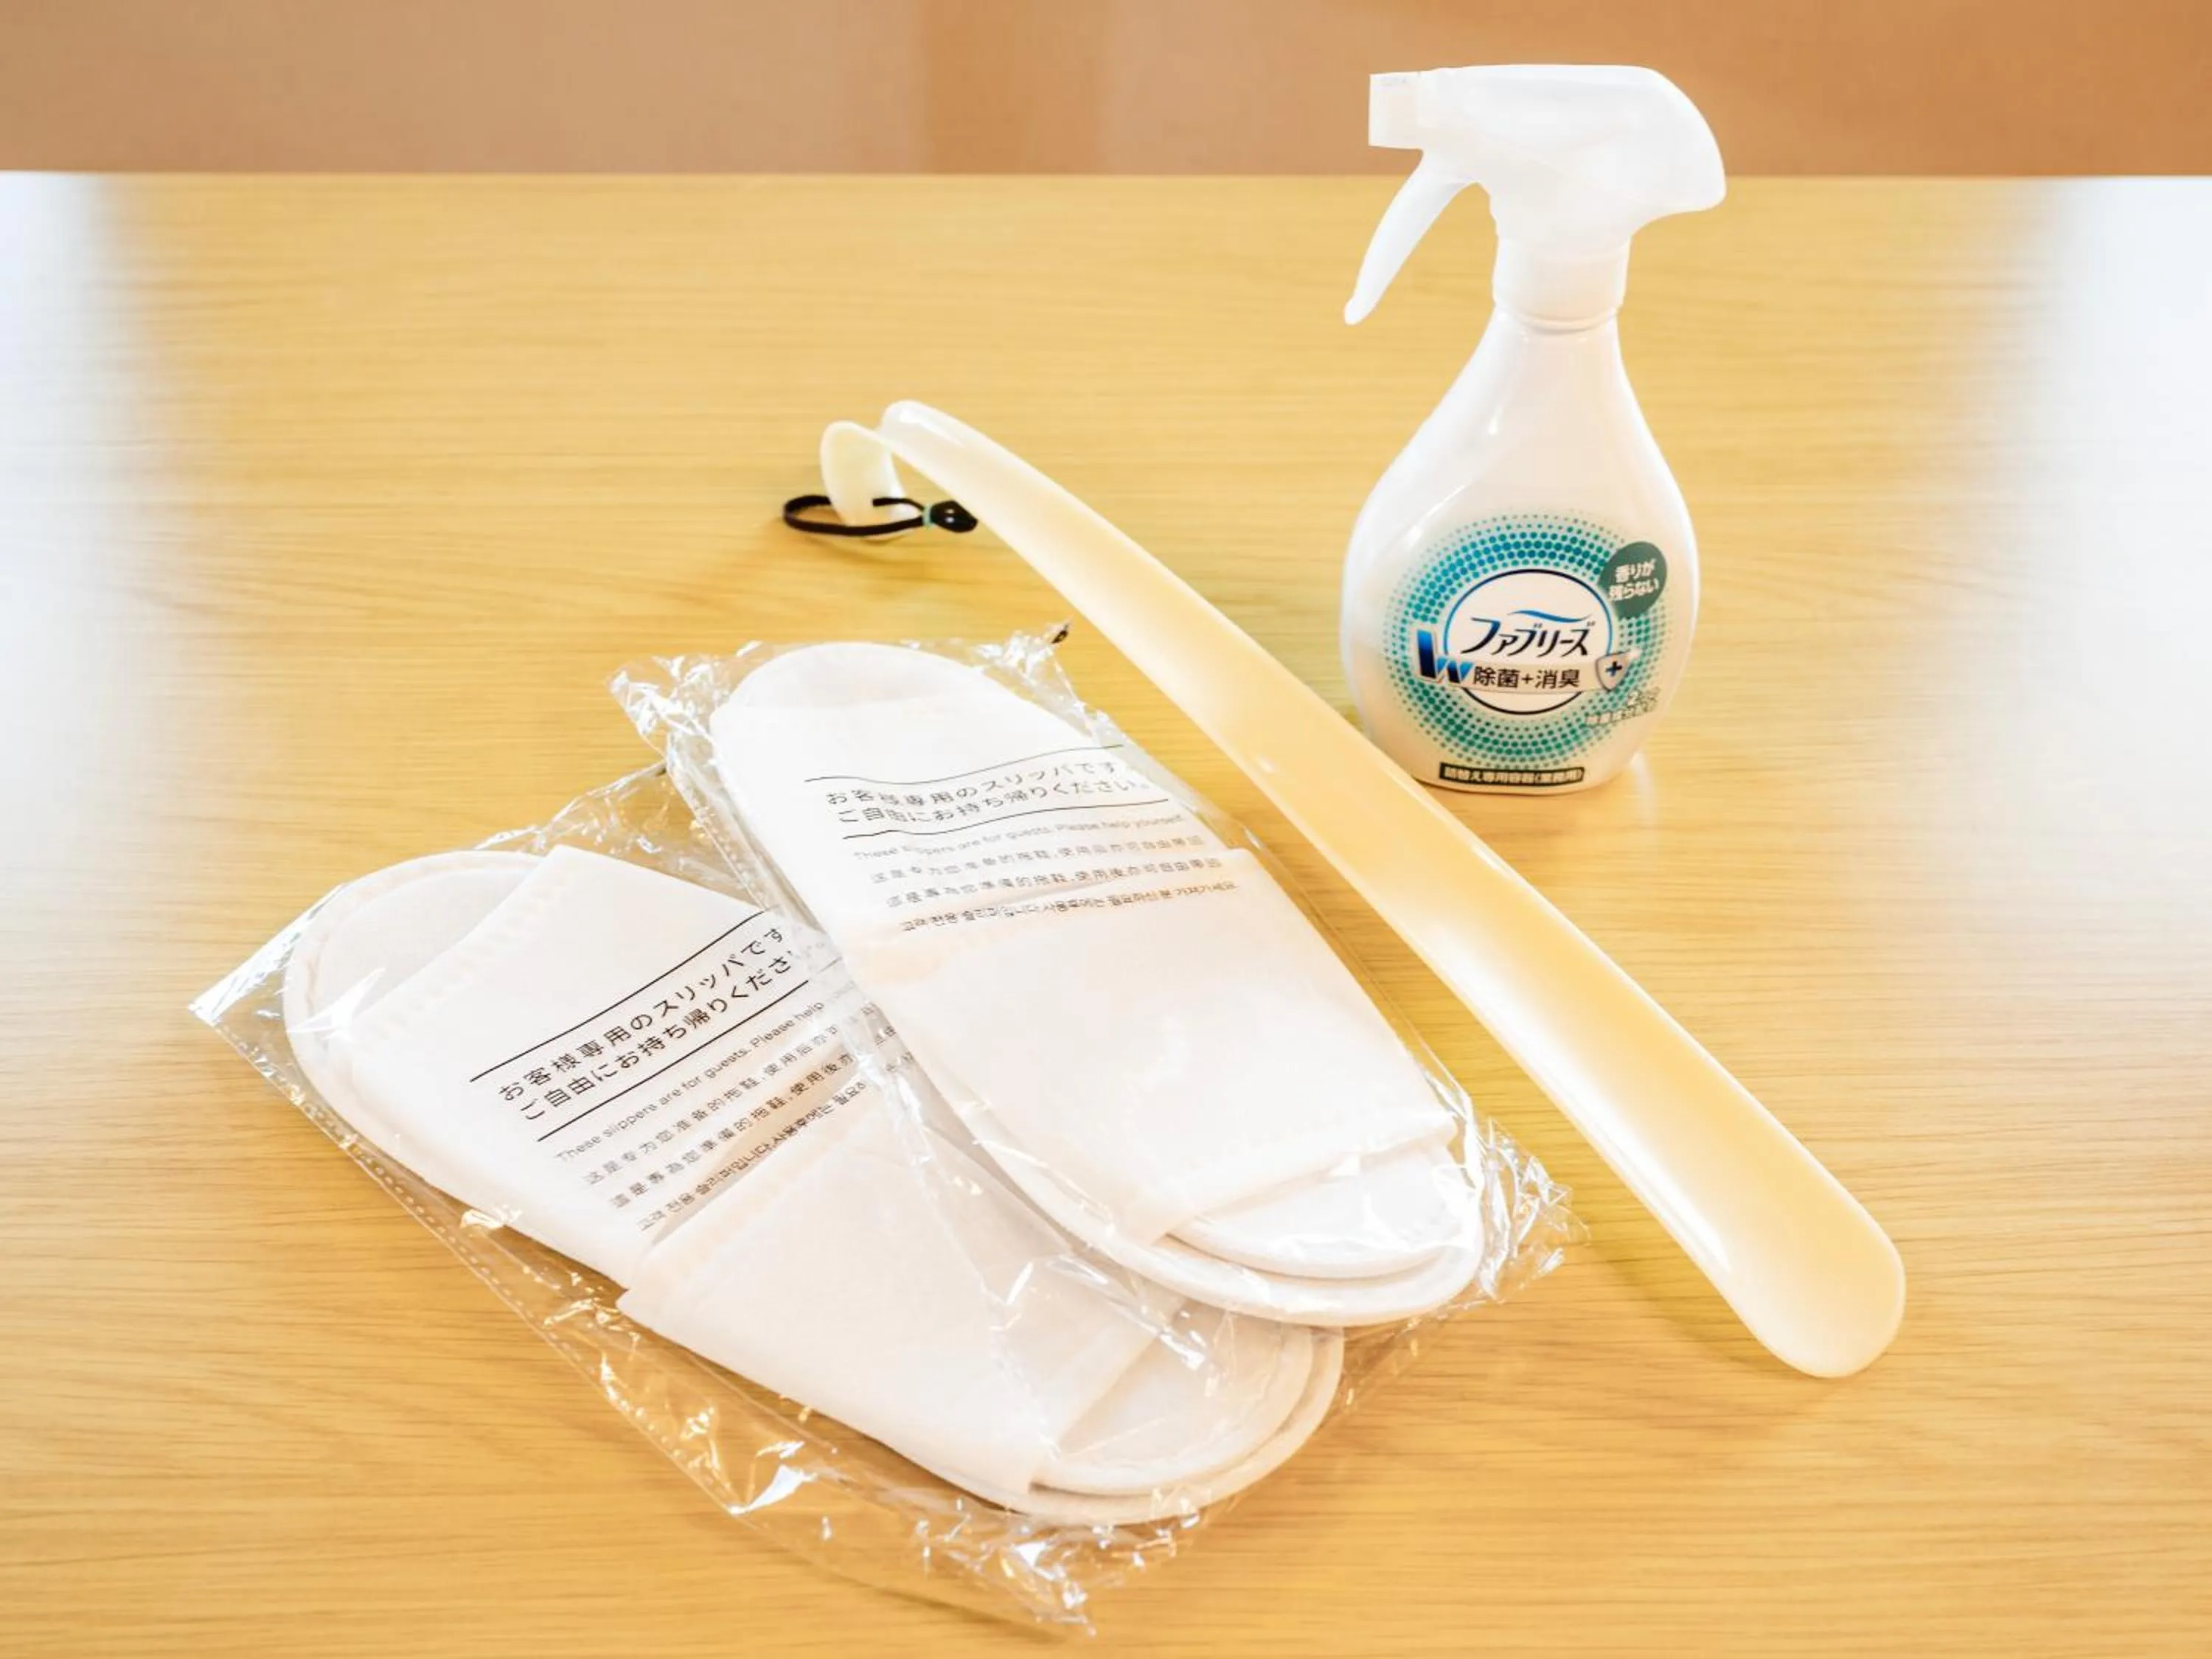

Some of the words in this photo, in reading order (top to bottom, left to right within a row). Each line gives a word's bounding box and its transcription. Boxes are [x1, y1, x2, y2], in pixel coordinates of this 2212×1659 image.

[1608, 578, 1659, 602] 残らない
[1615, 558, 1656, 583] 香りが
[1461, 617, 1596, 658] ファブリーズ
[1473, 666, 1580, 689] 除菌+消臭
[827, 762, 1117, 807] お客様専用のスリッパです
[498, 927, 783, 1101] お客様専用のスリッパです
[521, 947, 807, 1121] ご自由にお持ち帰りくださ
[554, 1135, 602, 1161] These
[602, 1103, 658, 1138] slippers
[660, 1088, 683, 1105] are
[681, 1076, 703, 1091] for
[750, 1019, 796, 1048] Please
[794, 1001, 825, 1021] help
